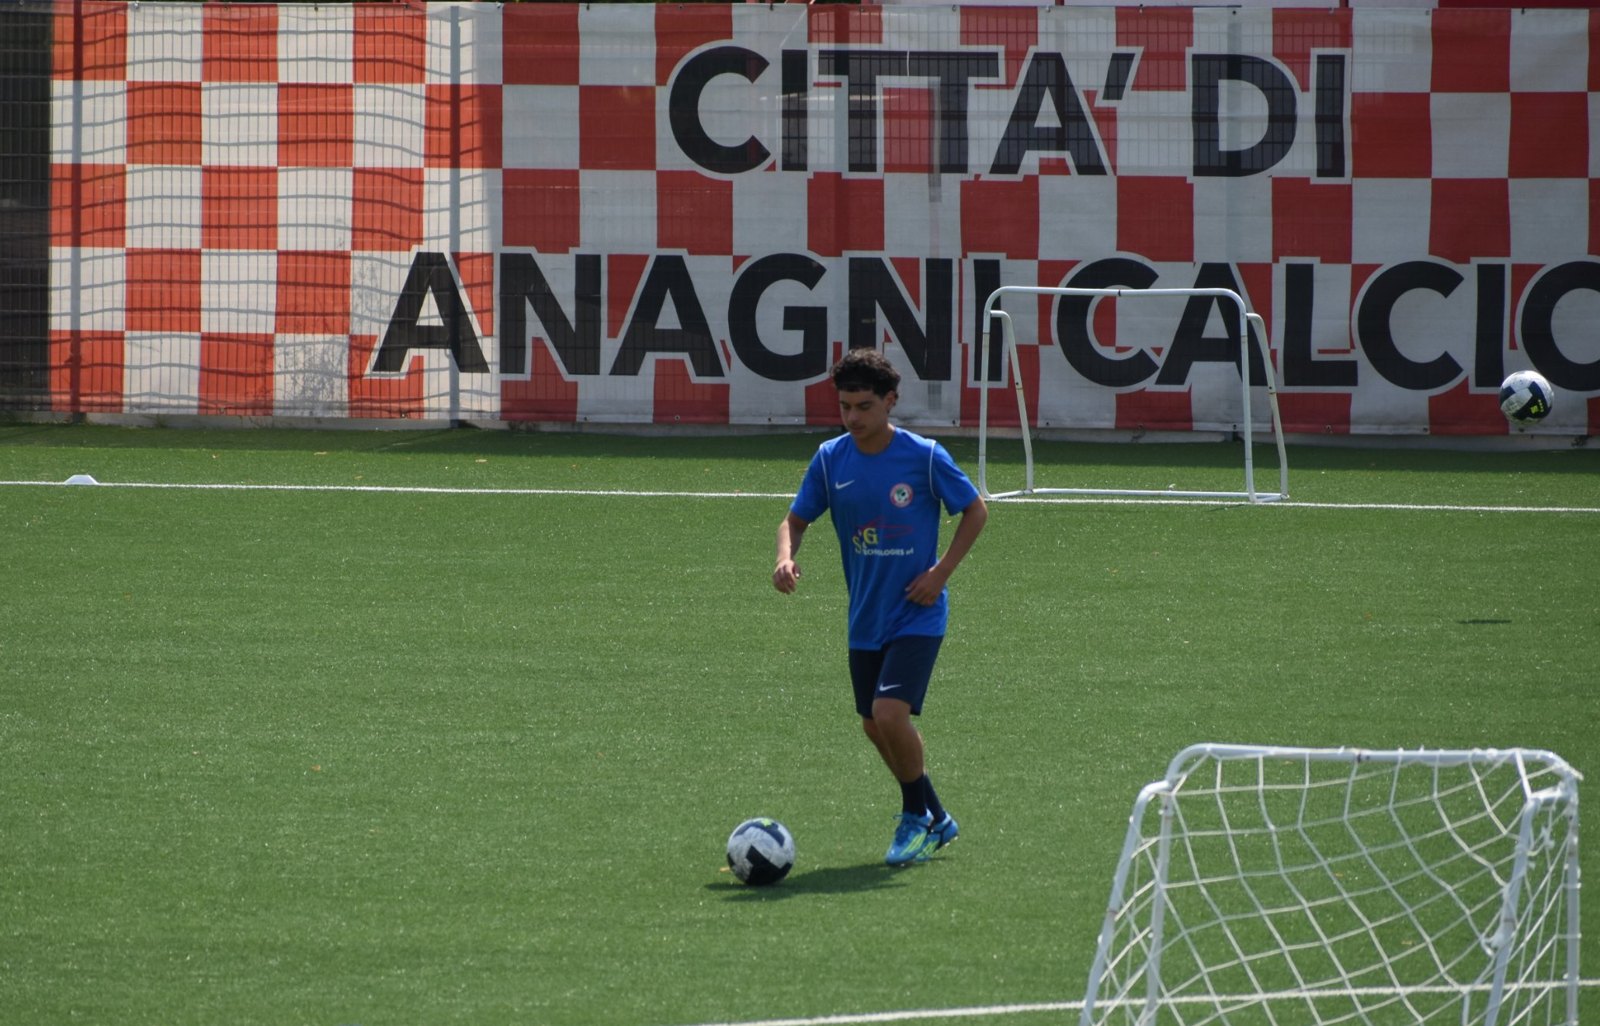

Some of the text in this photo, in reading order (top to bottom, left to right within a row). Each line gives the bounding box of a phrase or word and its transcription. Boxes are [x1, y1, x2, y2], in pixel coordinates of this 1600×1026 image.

[669, 45, 1346, 178] CITTA' DI
[371, 250, 1001, 382] ANAGNI
